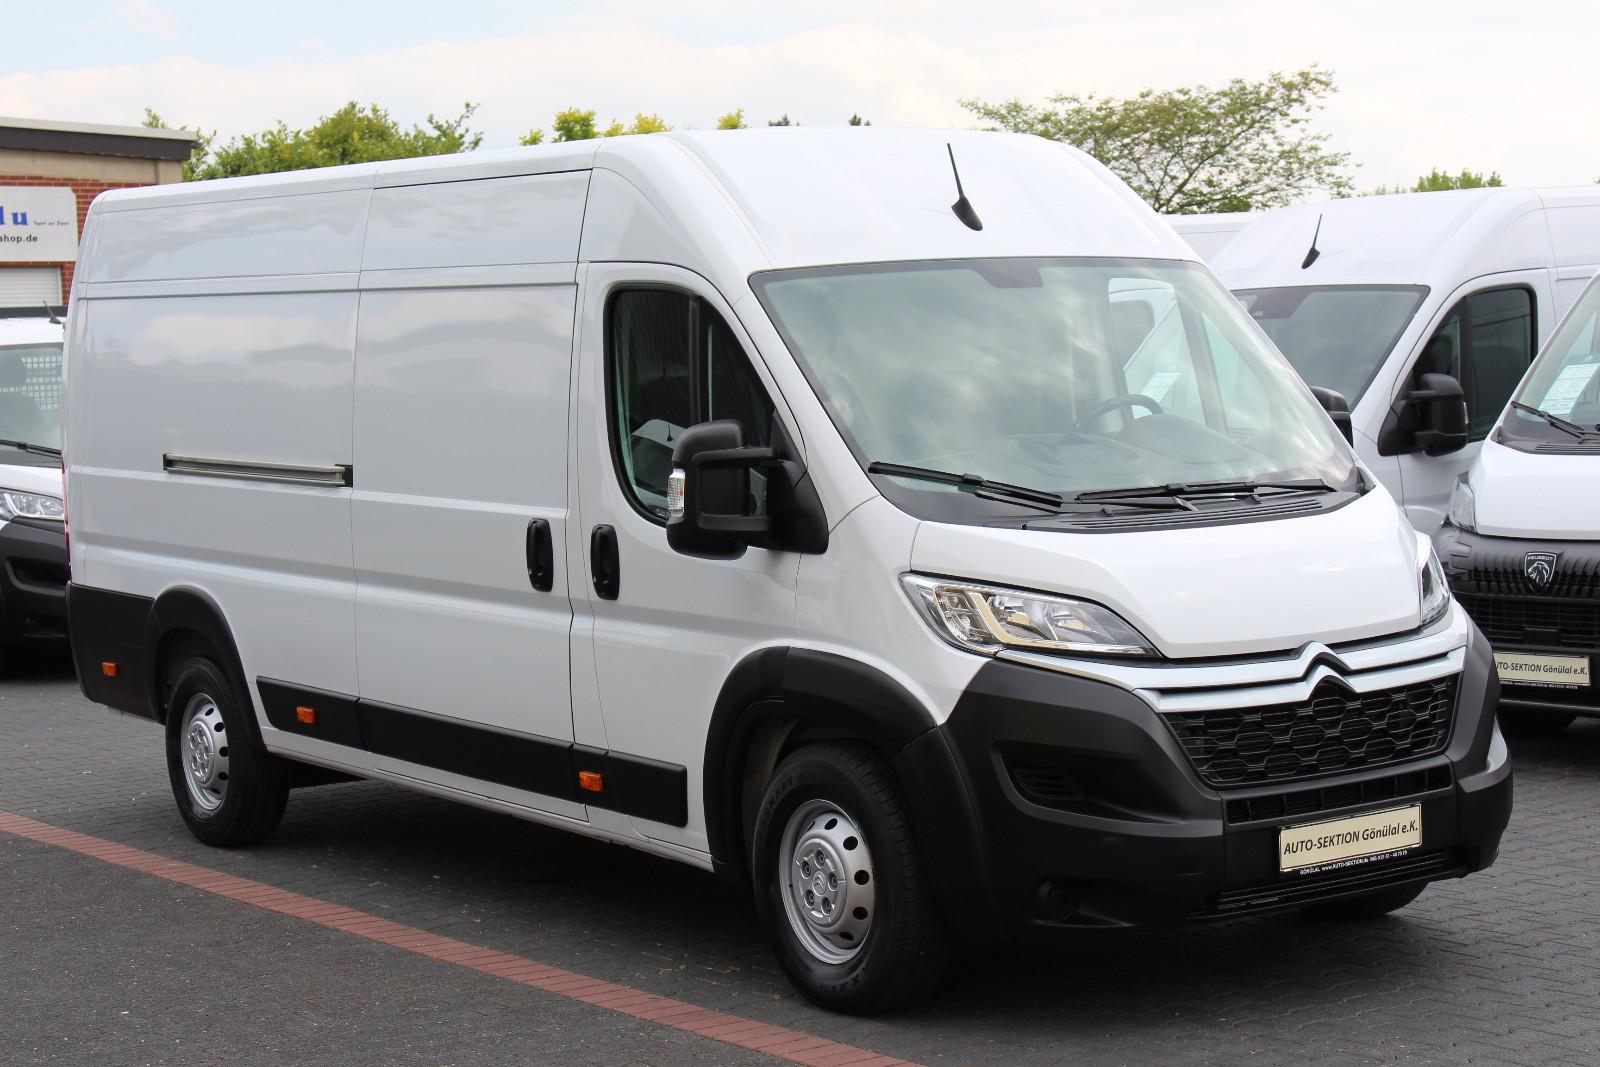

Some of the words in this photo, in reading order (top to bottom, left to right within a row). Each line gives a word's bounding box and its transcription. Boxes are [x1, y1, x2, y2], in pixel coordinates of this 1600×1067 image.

[1543, 663, 1572, 675] Gönülal
[1573, 666, 1588, 676] e.K.
[1284, 830, 1360, 855] AUTO-SEKTION
[1362, 823, 1400, 841] Gönülal
[1401, 820, 1418, 833] e.K.
